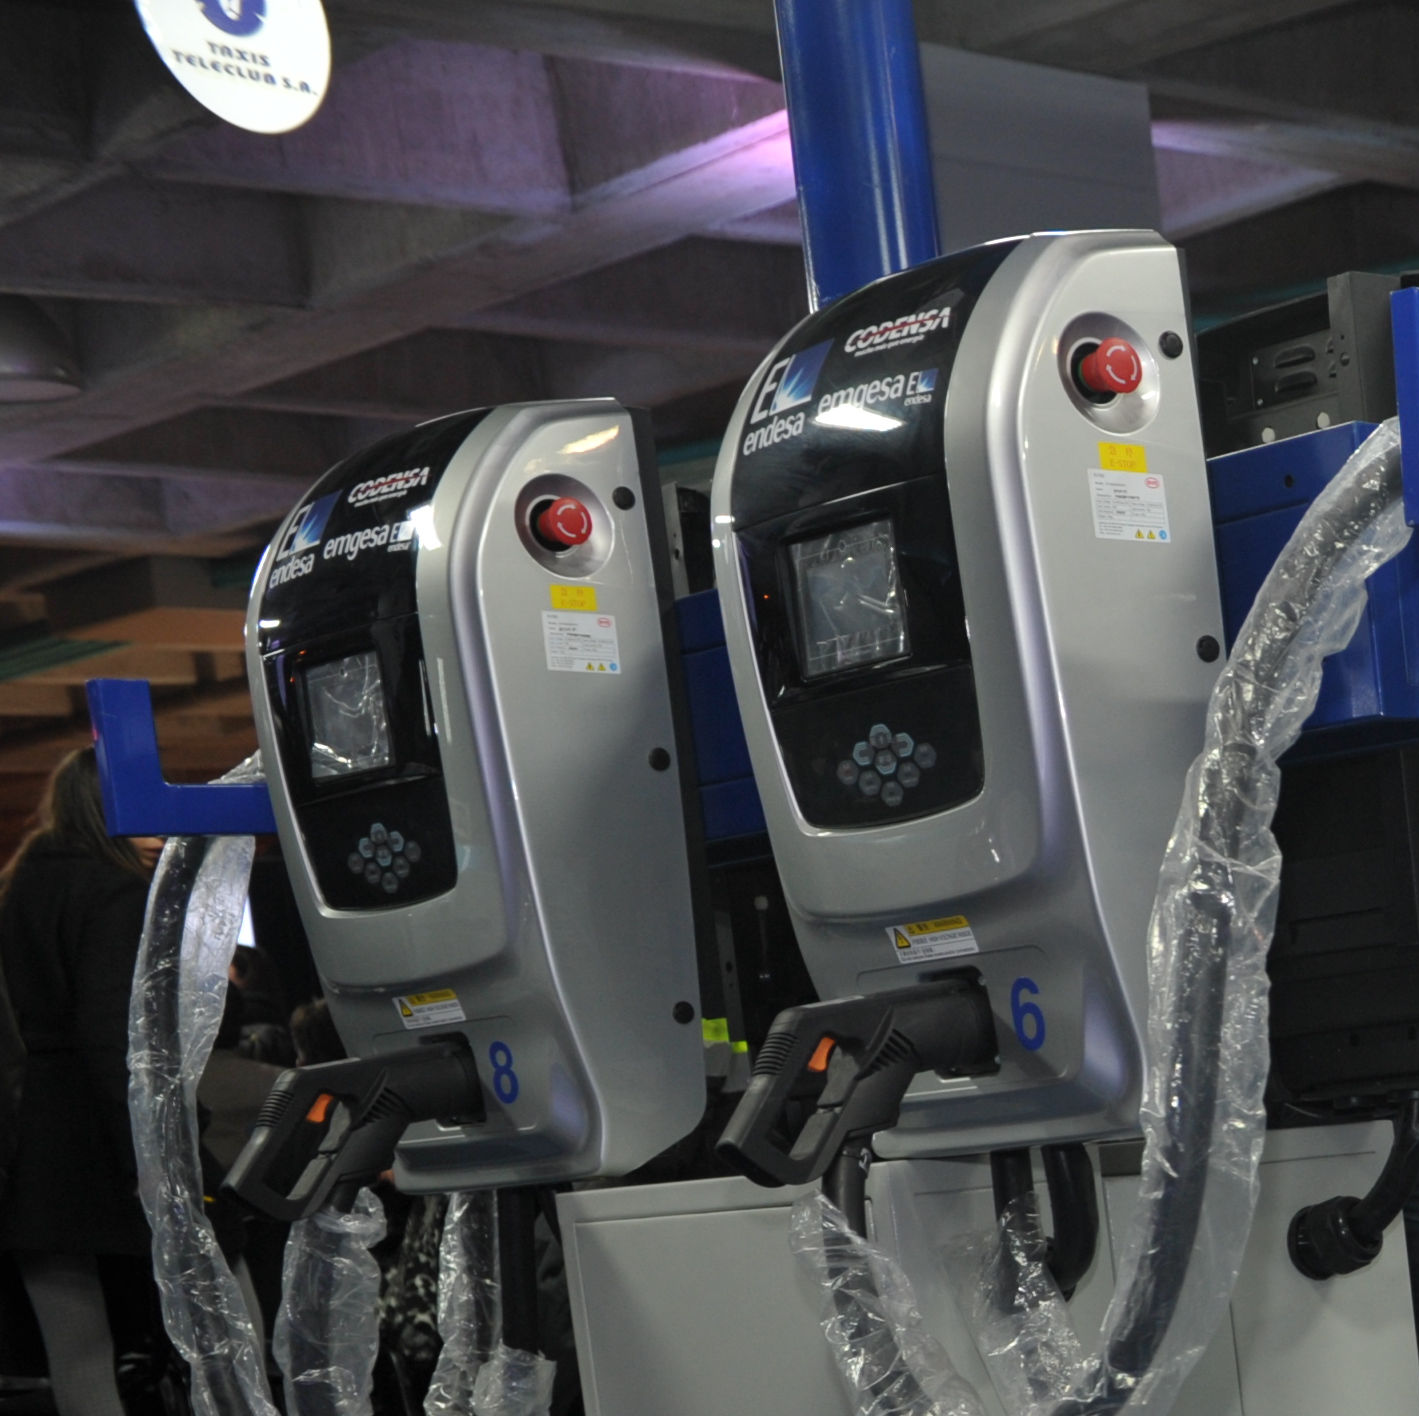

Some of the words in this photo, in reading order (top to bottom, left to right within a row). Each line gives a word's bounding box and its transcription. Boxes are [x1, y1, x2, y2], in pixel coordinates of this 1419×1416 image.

[171, 49, 277, 86] TELECLUB
[206, 40, 271, 67] TAXIS
[844, 307, 952, 353] CODENSA
[743, 412, 805, 456] endesa
[348, 467, 430, 503] CODENSA
[323, 524, 390, 561] emgesa
[269, 553, 315, 589] endesa
[1010, 976, 1046, 1052] 6
[489, 1041, 519, 1104] 8
